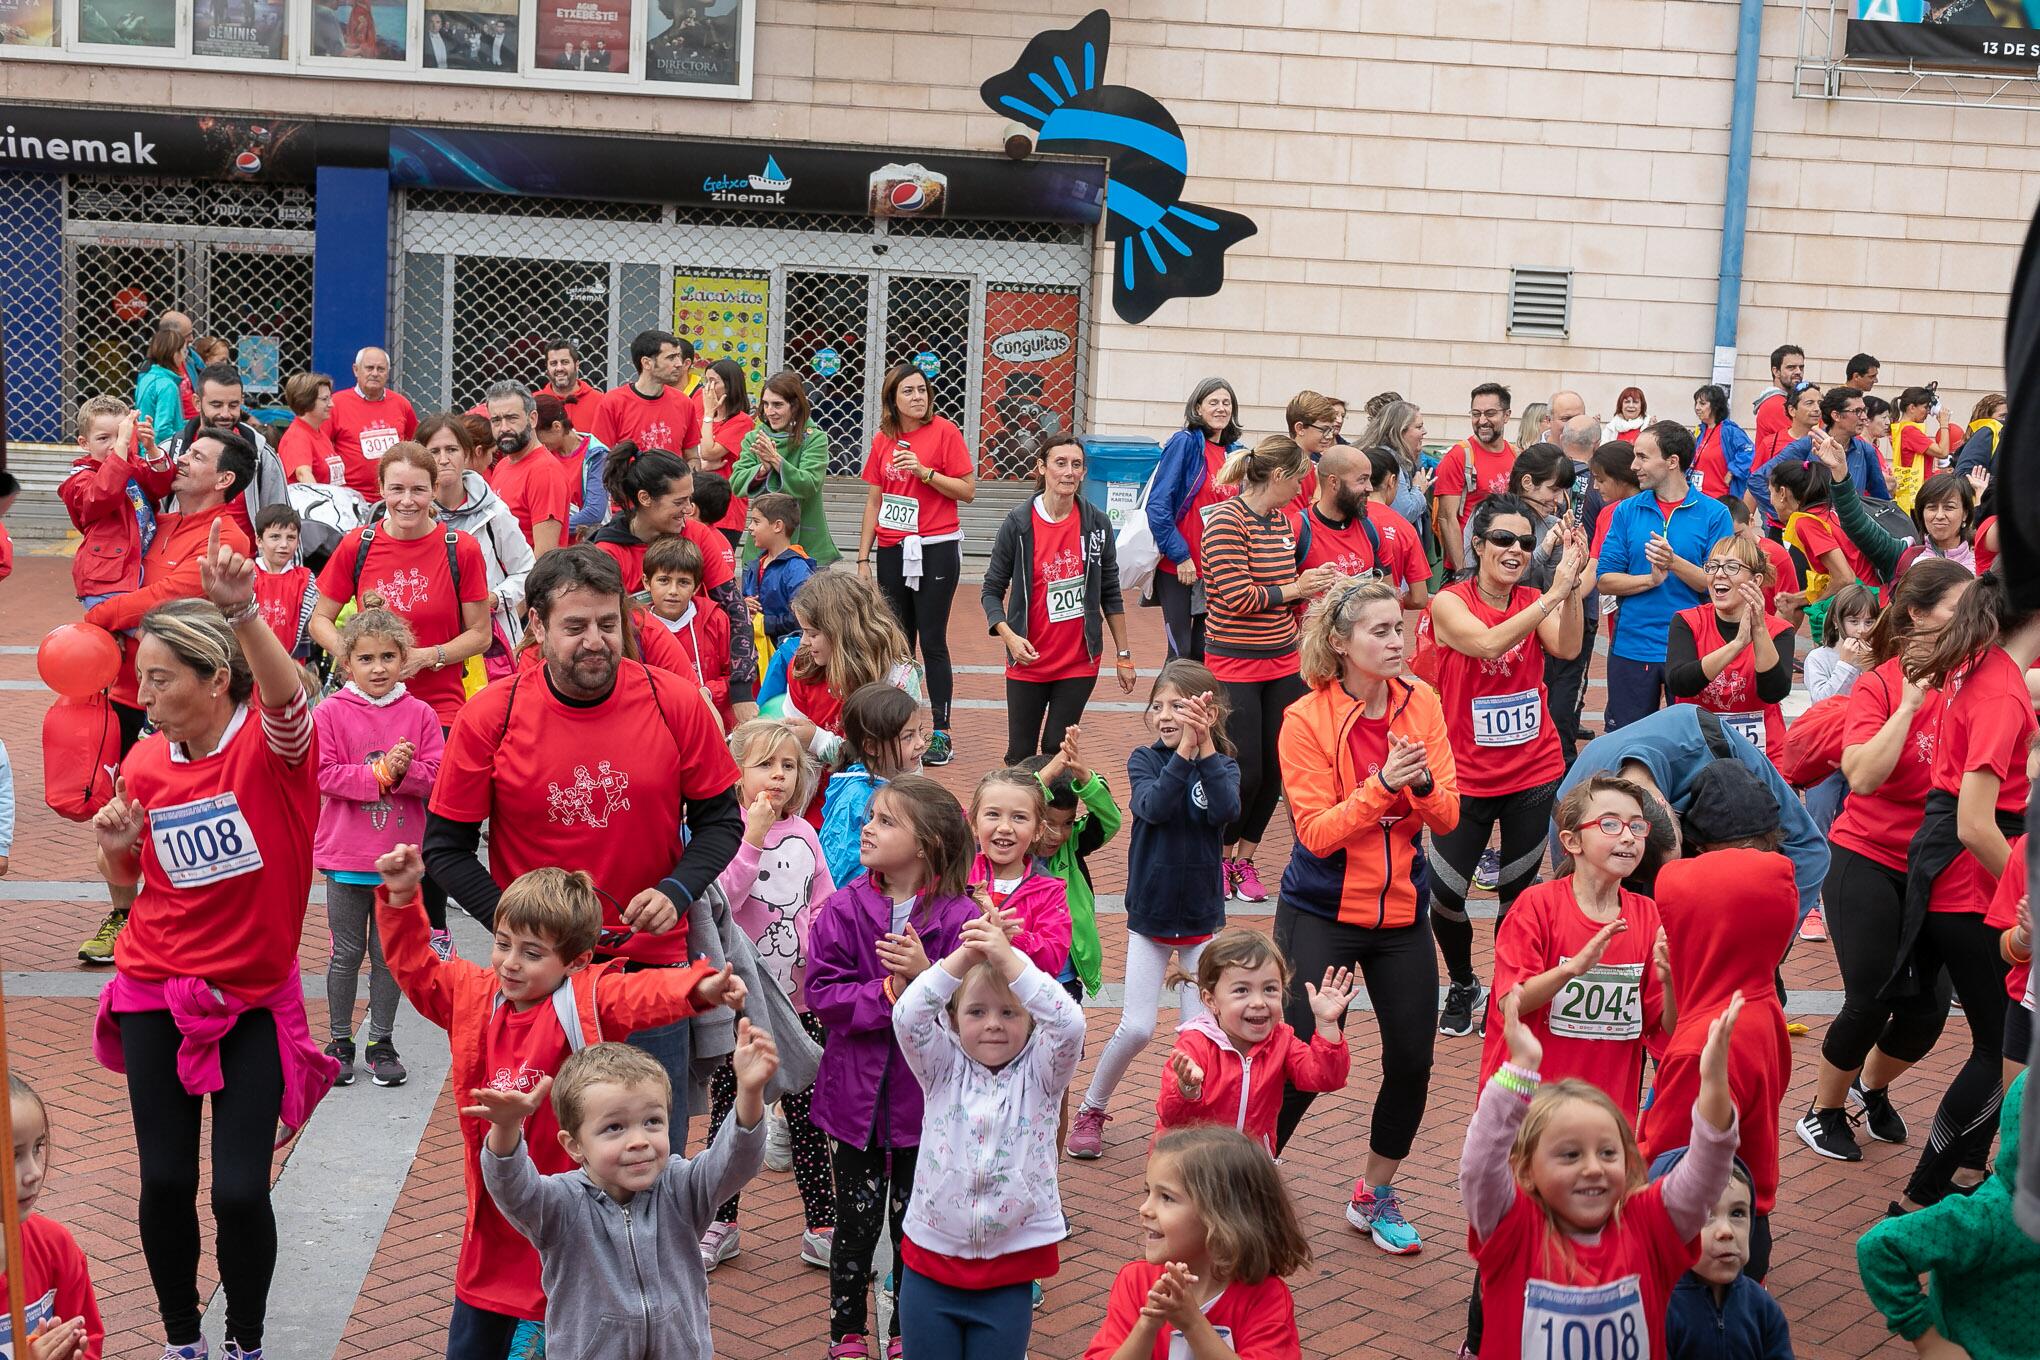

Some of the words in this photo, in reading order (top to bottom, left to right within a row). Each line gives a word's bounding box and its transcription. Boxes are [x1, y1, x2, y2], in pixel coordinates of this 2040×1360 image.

[556, 8, 618, 21] ETXEBESTE!
[1983, 41, 1998, 55] 13
[2003, 43, 2025, 56] DE
[657, 59, 718, 72] DIRECTORA
[703, 174, 748, 192] Getxo
[711, 189, 785, 204] zinemak
[680, 286, 763, 305] Lacasitos
[996, 334, 1068, 357] conguitos
[884, 503, 915, 524] 2037
[1481, 704, 1536, 734] 1015
[163, 818, 243, 868] 1008
[1561, 981, 1639, 1022] 2045
[1541, 1311, 1640, 1360] 1008
